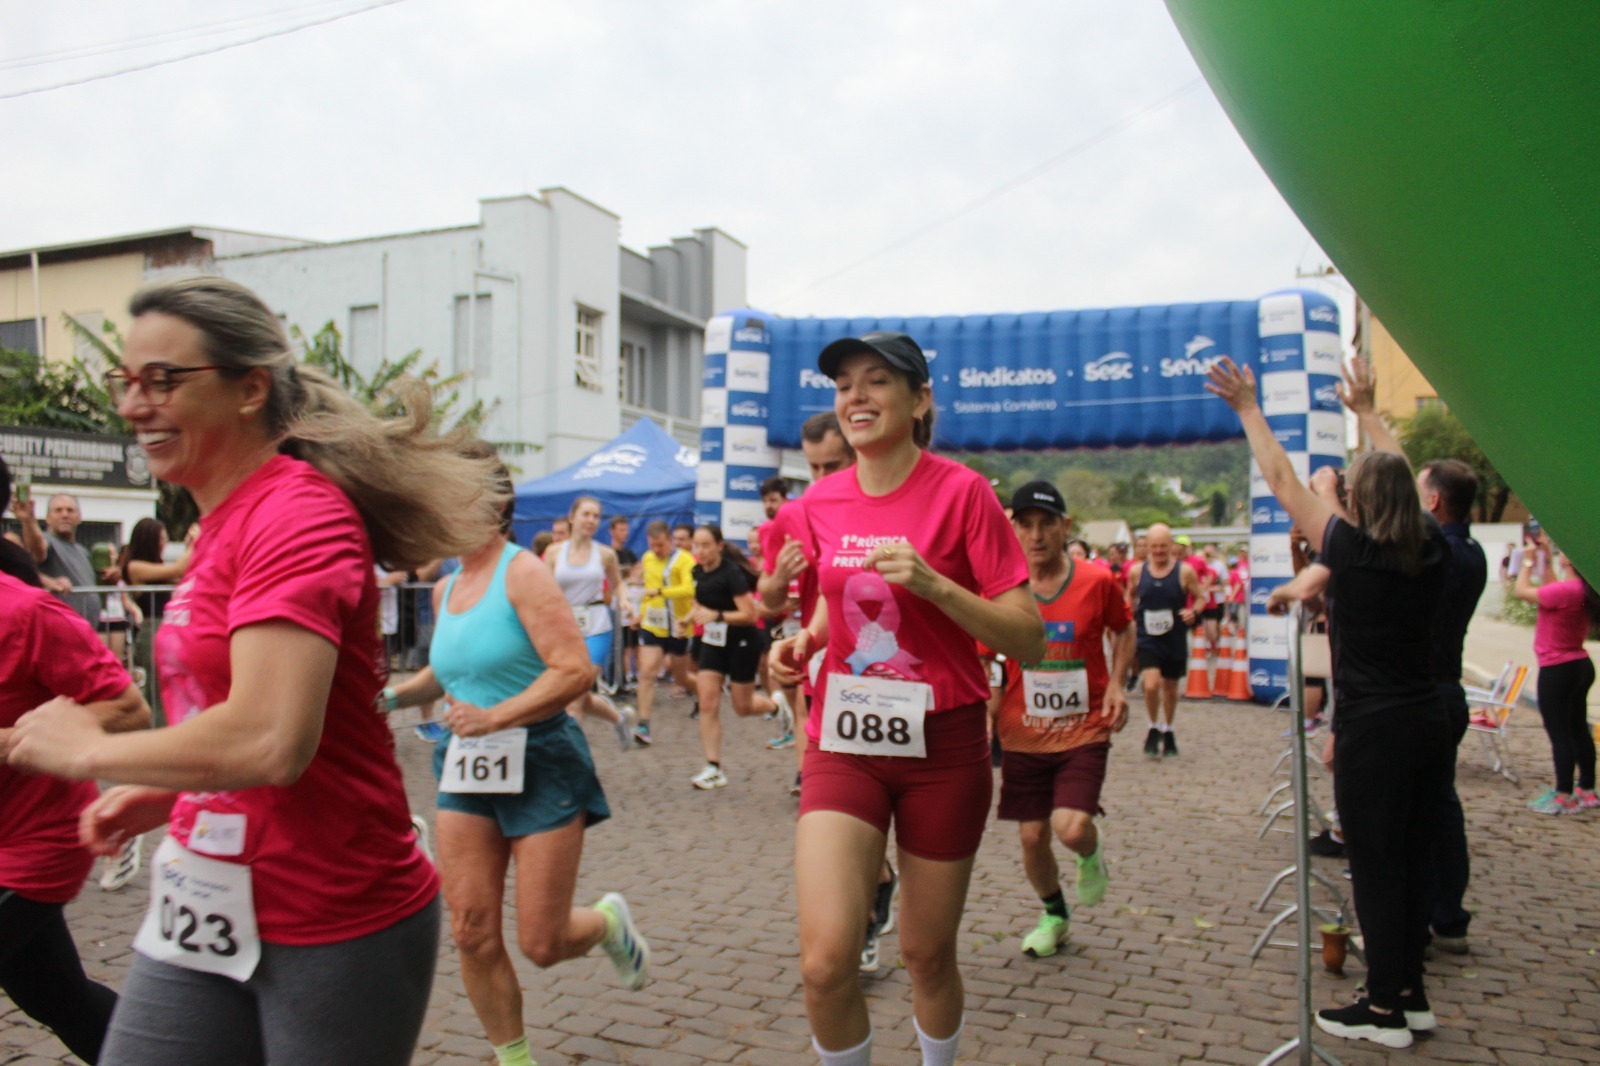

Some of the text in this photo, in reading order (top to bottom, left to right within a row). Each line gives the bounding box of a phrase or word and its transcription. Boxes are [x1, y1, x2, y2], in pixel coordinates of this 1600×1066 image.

[959, 367, 1057, 388] Sindicatos
[1084, 361, 1133, 381] Sesc
[953, 399, 1057, 413] Sistema Comércio
[840, 689, 871, 705] Sesc
[1034, 692, 1081, 710] 004
[837, 710, 911, 745] 088
[456, 755, 508, 781] 161
